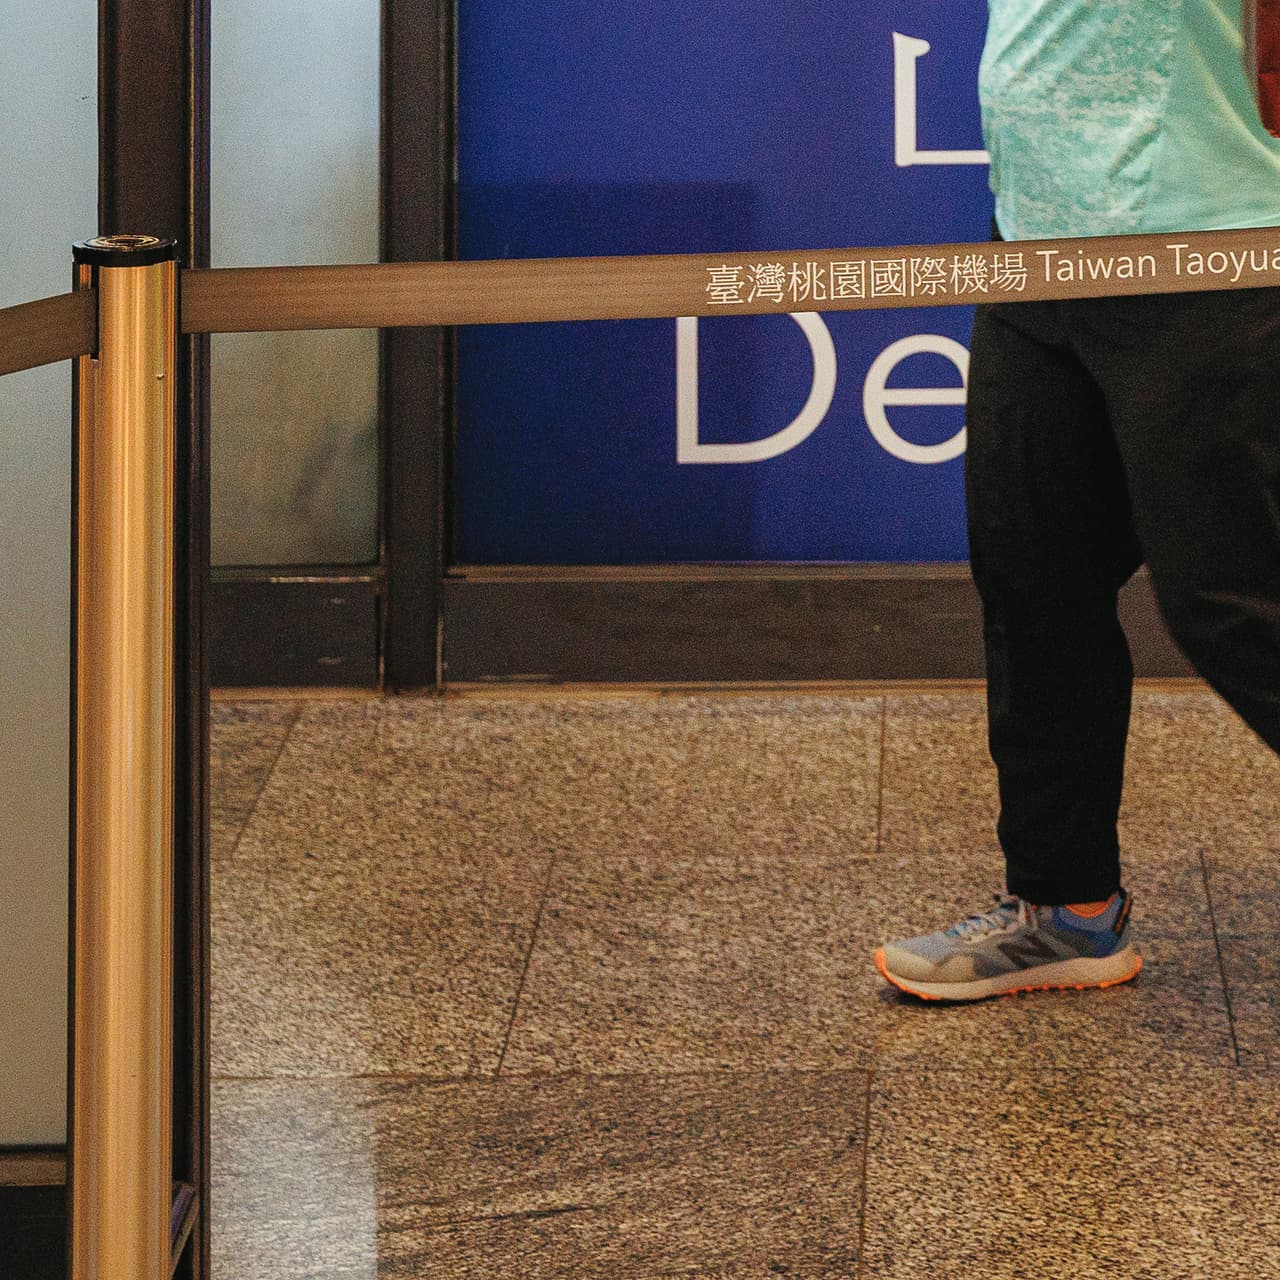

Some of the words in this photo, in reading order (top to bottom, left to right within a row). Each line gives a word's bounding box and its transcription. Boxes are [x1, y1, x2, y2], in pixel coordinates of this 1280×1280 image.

[705, 252, 1028, 305] 臺灣桃園國際機場
[1036, 250, 1157, 282] Taiwan
